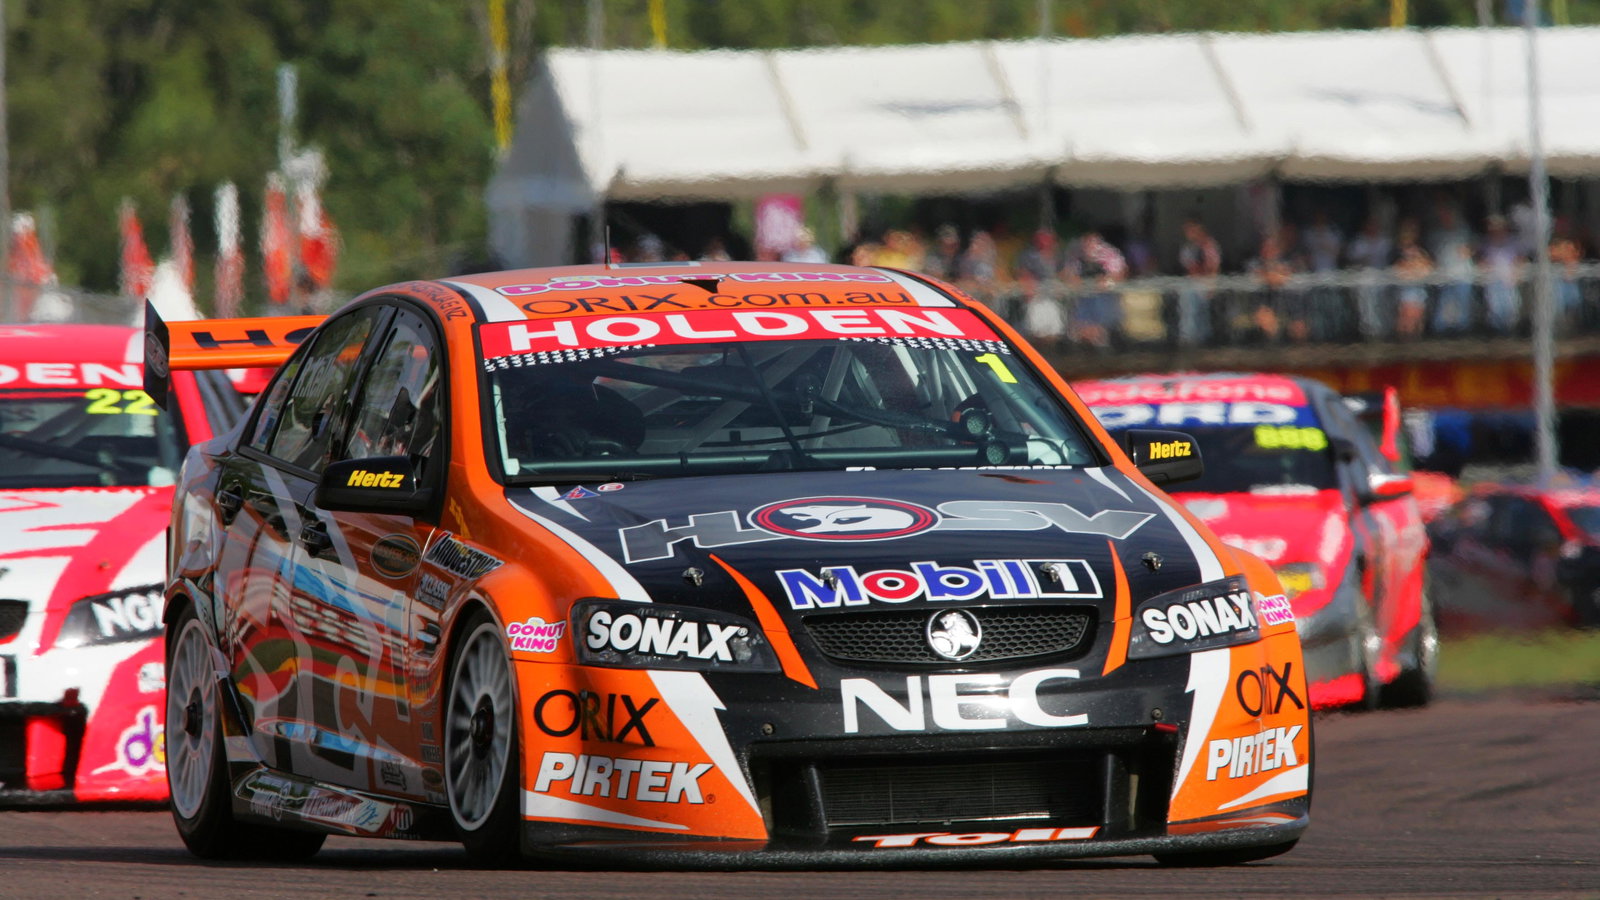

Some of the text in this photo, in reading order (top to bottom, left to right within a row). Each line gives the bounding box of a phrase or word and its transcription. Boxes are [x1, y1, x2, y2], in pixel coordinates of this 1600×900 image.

[730, 272, 893, 284] KING
[522, 291, 911, 314] ORIX.com.au
[508, 309, 966, 351] HOLDEN
[975, 353, 1018, 384] 1
[86, 388, 159, 416] 22
[1089, 402, 1297, 427] ORD
[1149, 440, 1192, 460] Hertz
[346, 470, 405, 488] Hertz
[775, 559, 1035, 609] Mobil
[1258, 596, 1289, 610] ONUT
[1265, 608, 1293, 622] KING
[509, 622, 565, 637] DONUT
[1142, 592, 1258, 644] SONAX
[514, 636, 555, 650] KING
[840, 668, 1089, 734] NEC
[533, 689, 660, 747] ORIX
[1206, 725, 1304, 782] PIRTEK
